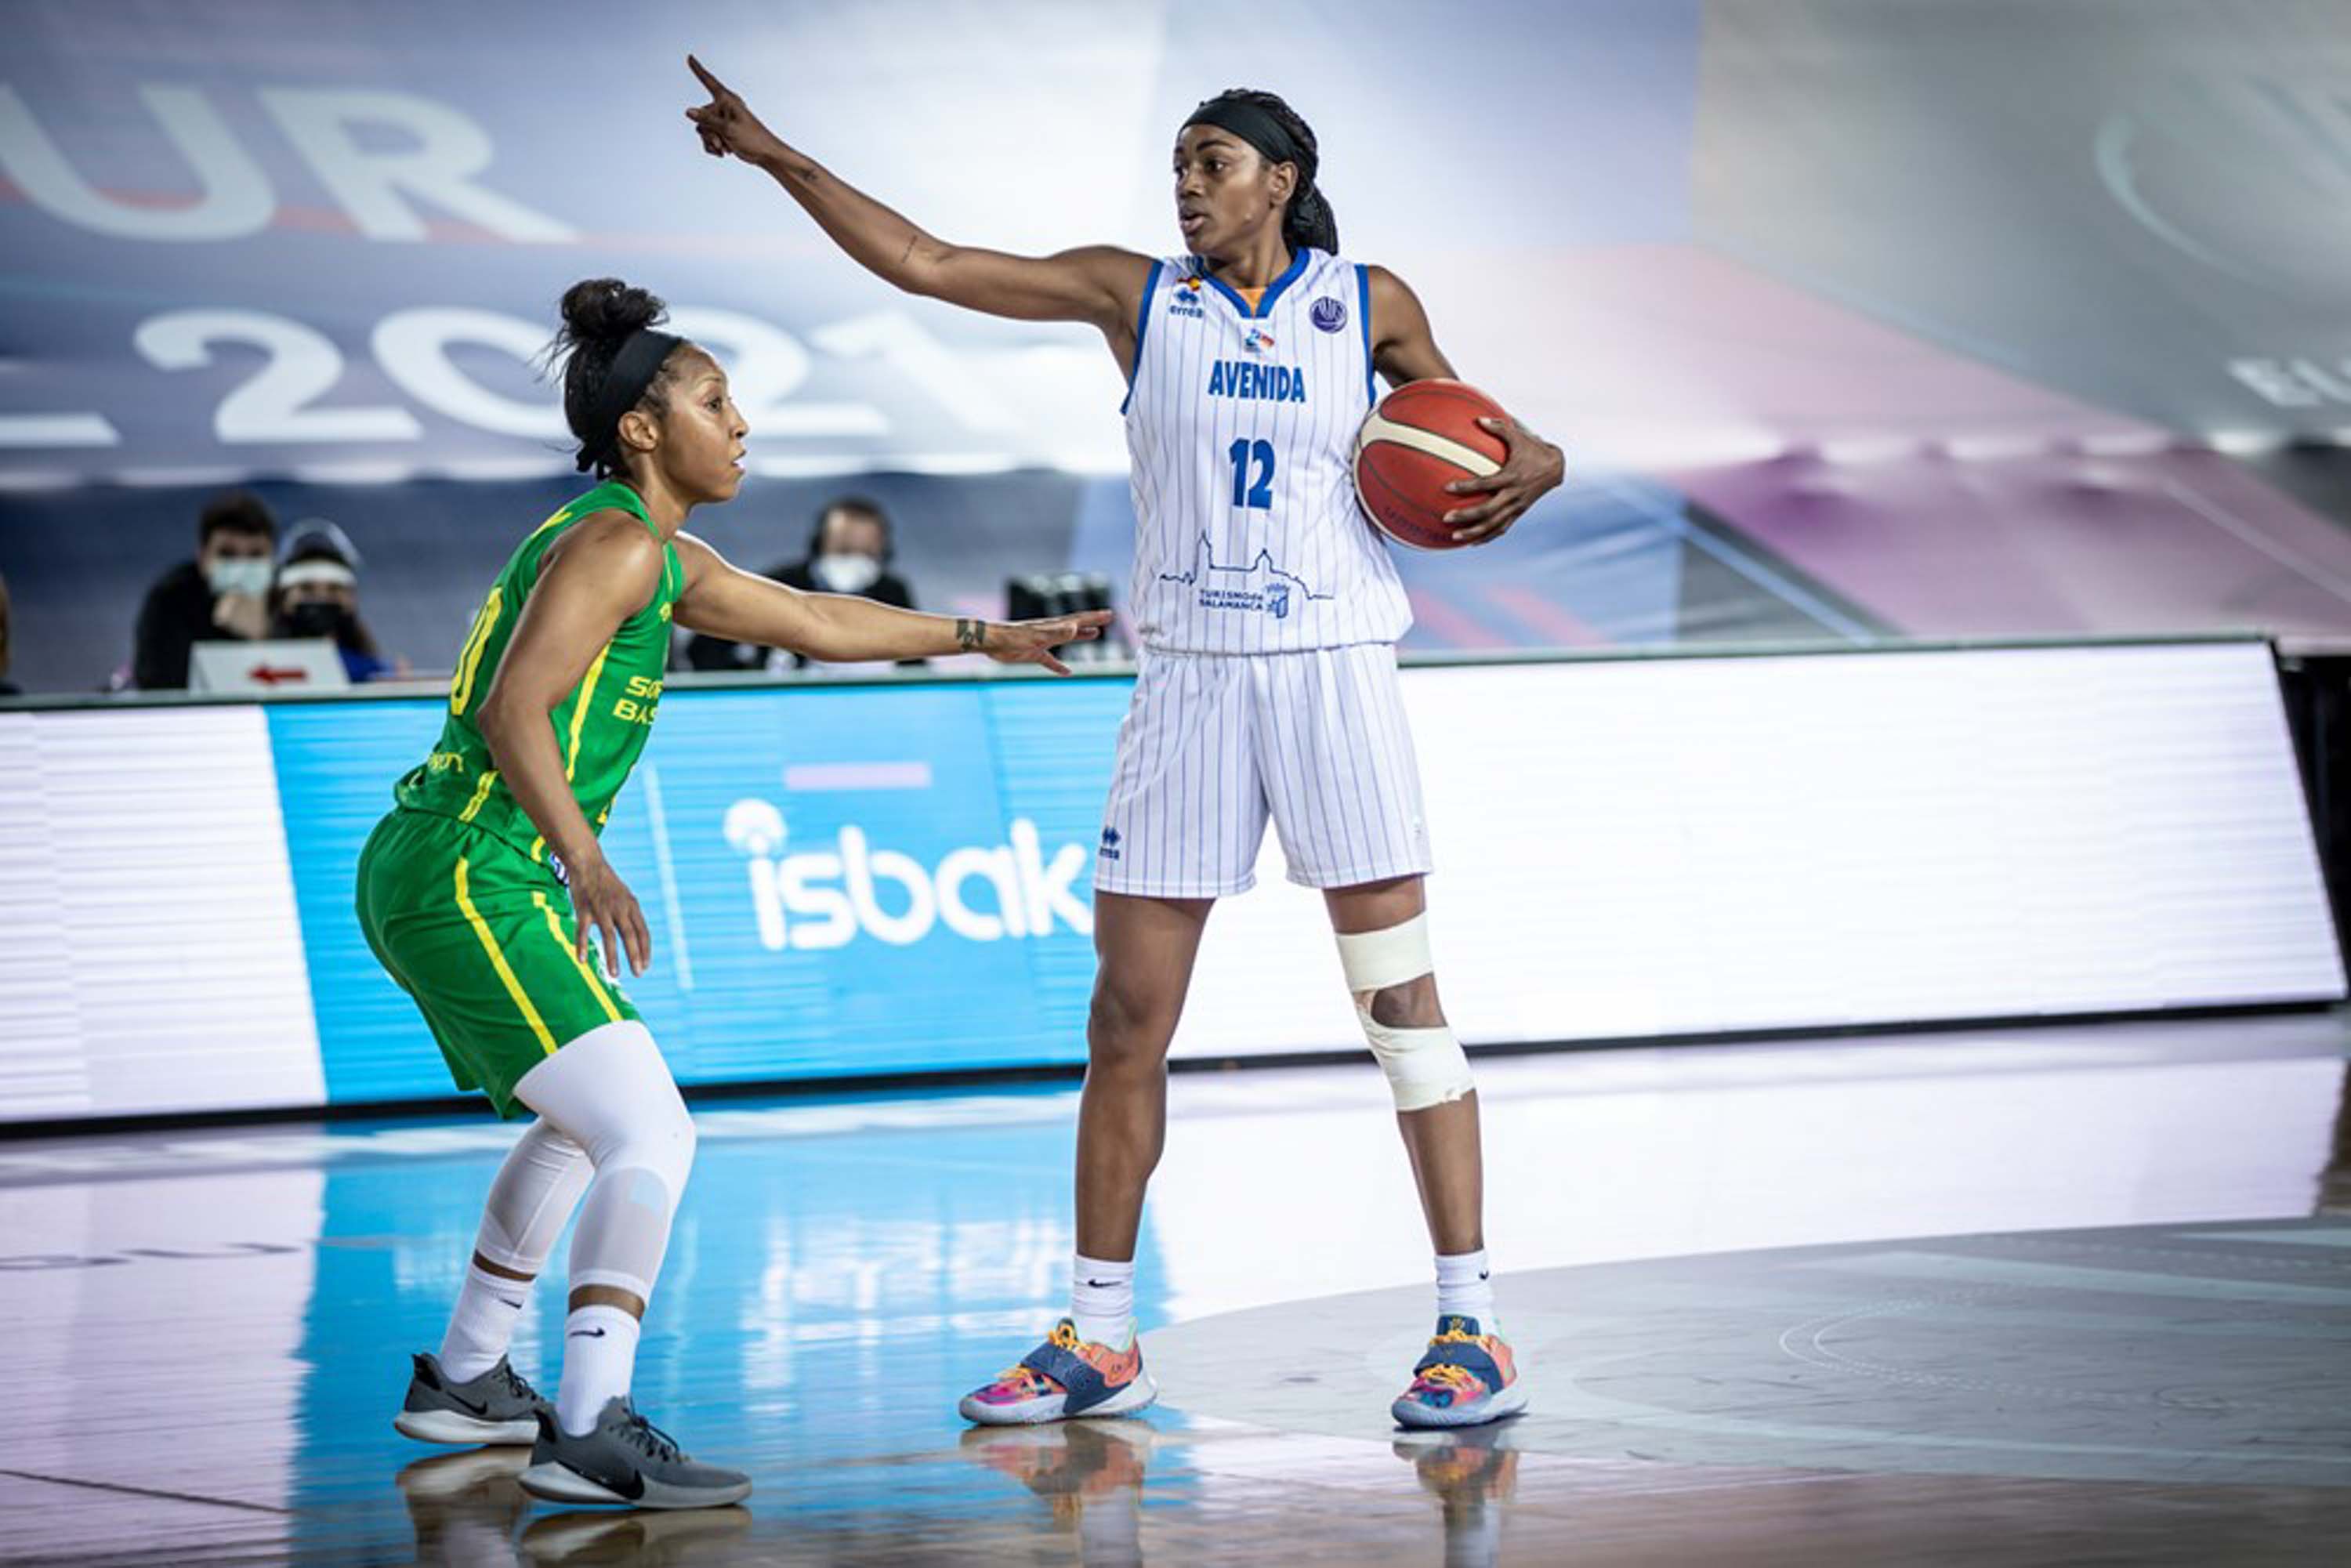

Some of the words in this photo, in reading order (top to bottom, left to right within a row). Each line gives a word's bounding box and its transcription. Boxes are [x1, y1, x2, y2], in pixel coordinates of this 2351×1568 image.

[1208, 360, 1306, 404] AVENIDA
[1229, 437, 1276, 510] 12
[723, 798, 1093, 951] isbak
